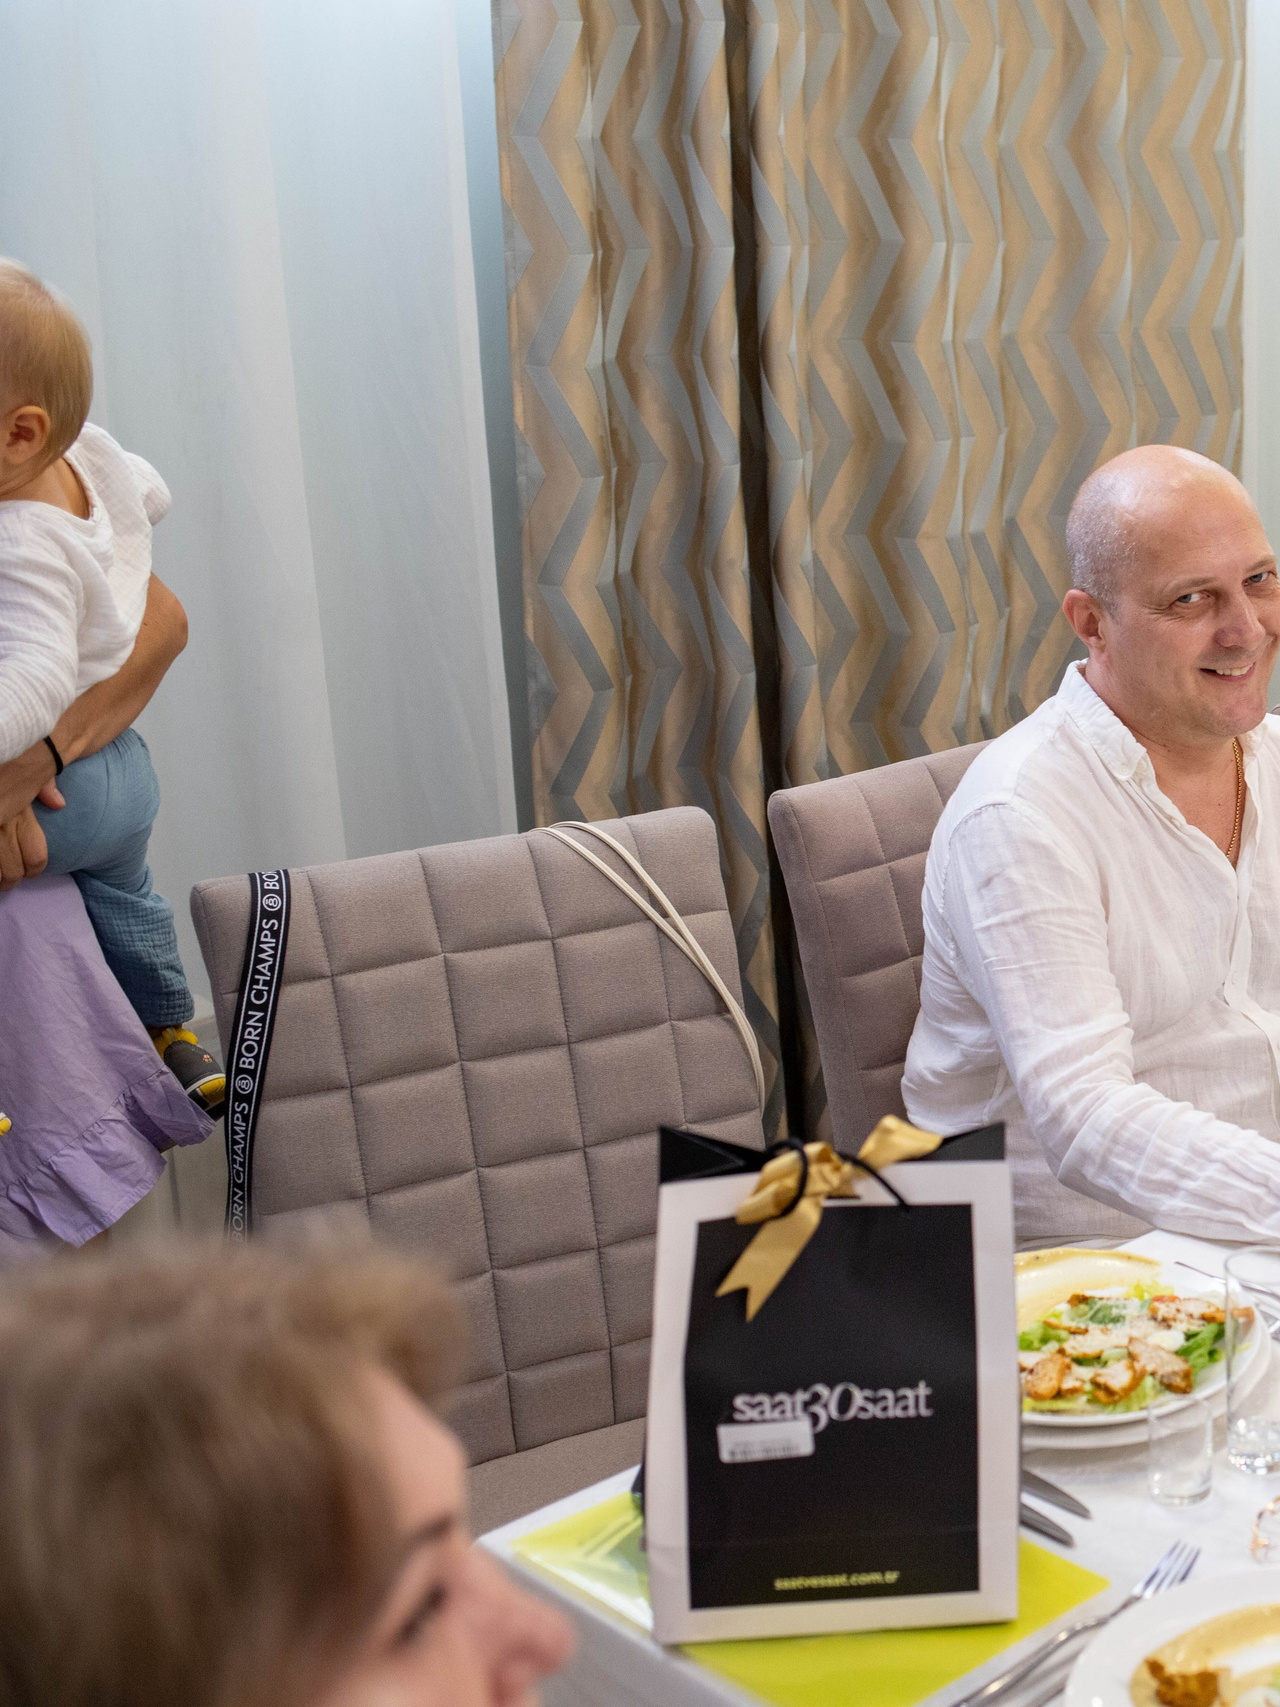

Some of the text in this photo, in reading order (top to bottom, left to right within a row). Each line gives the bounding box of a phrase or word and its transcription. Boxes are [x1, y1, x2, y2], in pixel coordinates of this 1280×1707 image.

[261, 871, 280, 890] BO
[238, 918, 279, 1070] BORN CHAMPS
[231, 1102, 249, 1242] BORN CHAMPS
